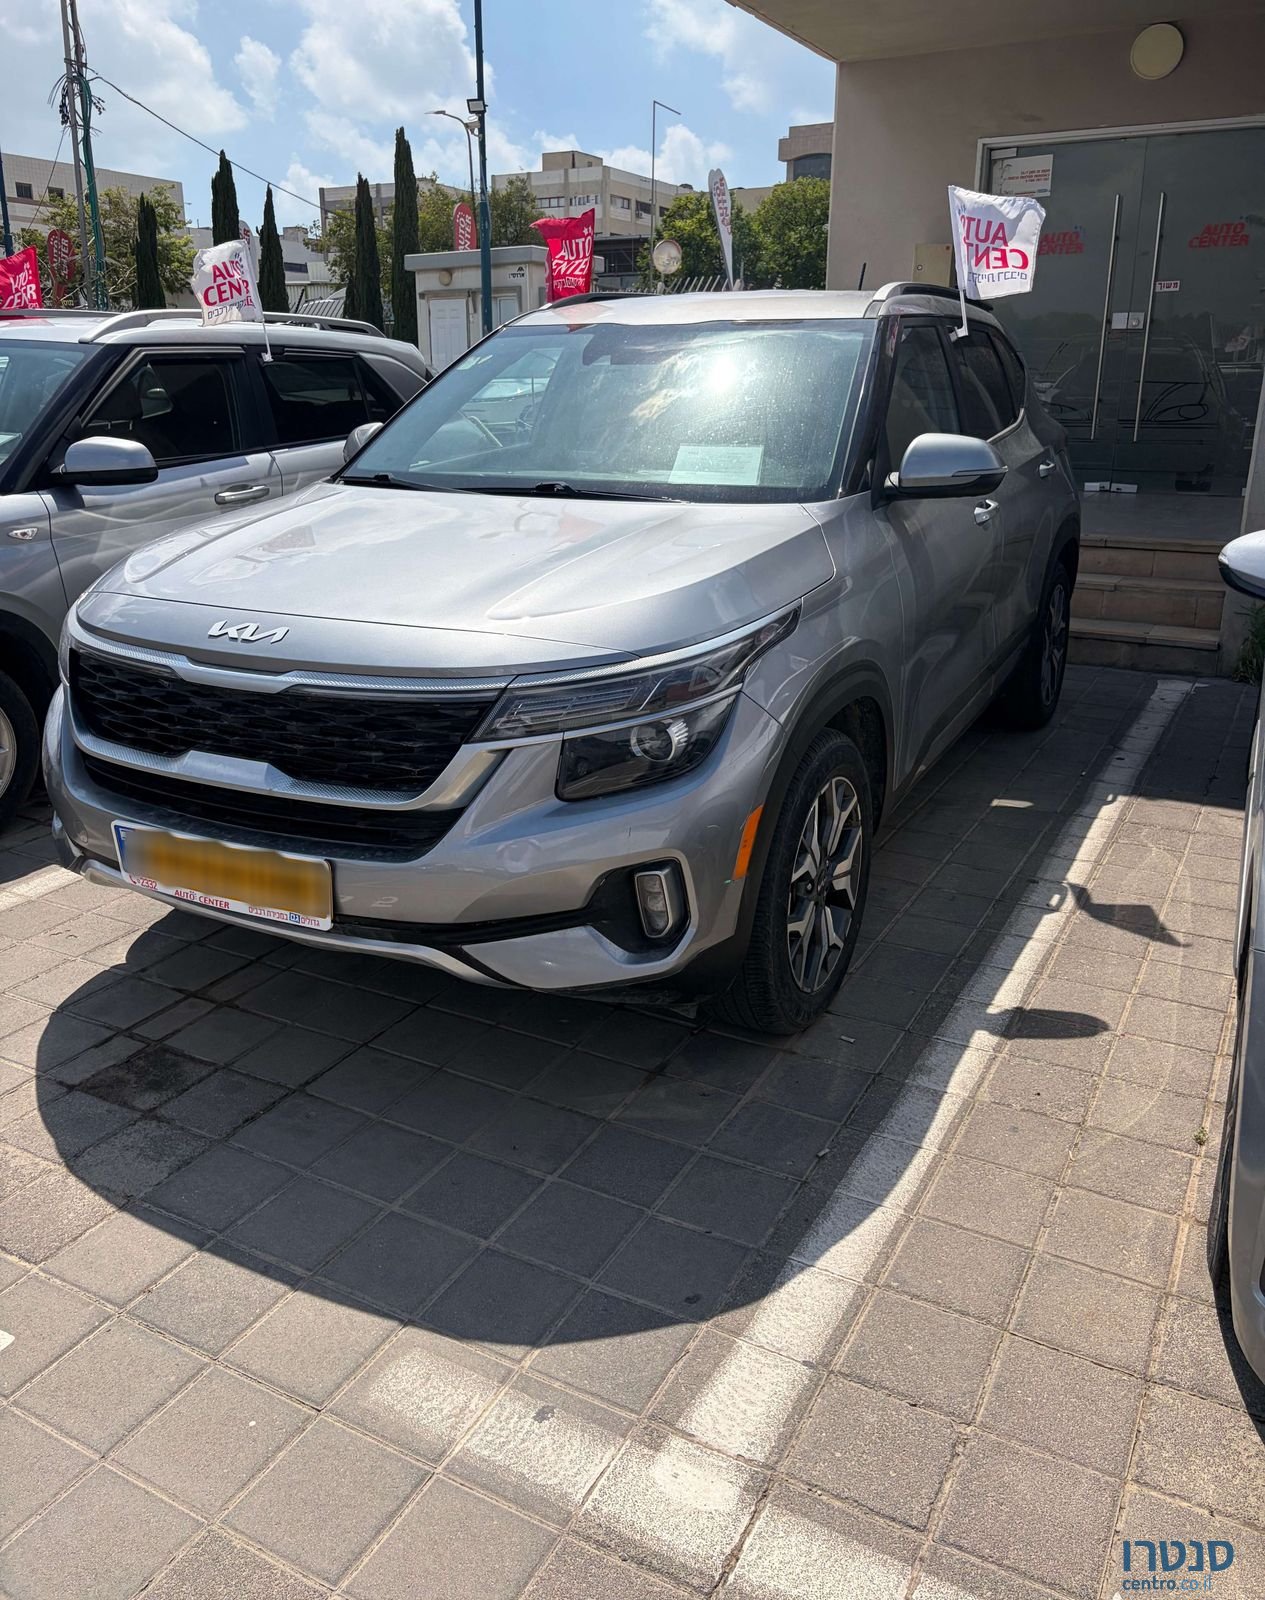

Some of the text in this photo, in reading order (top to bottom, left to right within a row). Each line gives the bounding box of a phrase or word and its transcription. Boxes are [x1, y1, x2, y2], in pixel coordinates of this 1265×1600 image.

[1204, 222, 1246, 235] AUTO
[555, 236, 592, 261] AUTO
[1039, 241, 1085, 255] ENTER
[1189, 234, 1250, 249] CENTER
[1158, 281, 1178, 290] משוך
[207, 619, 290, 644] KIA
[175, 889, 195, 901] AUTO
[198, 895, 230, 909] CENTER
